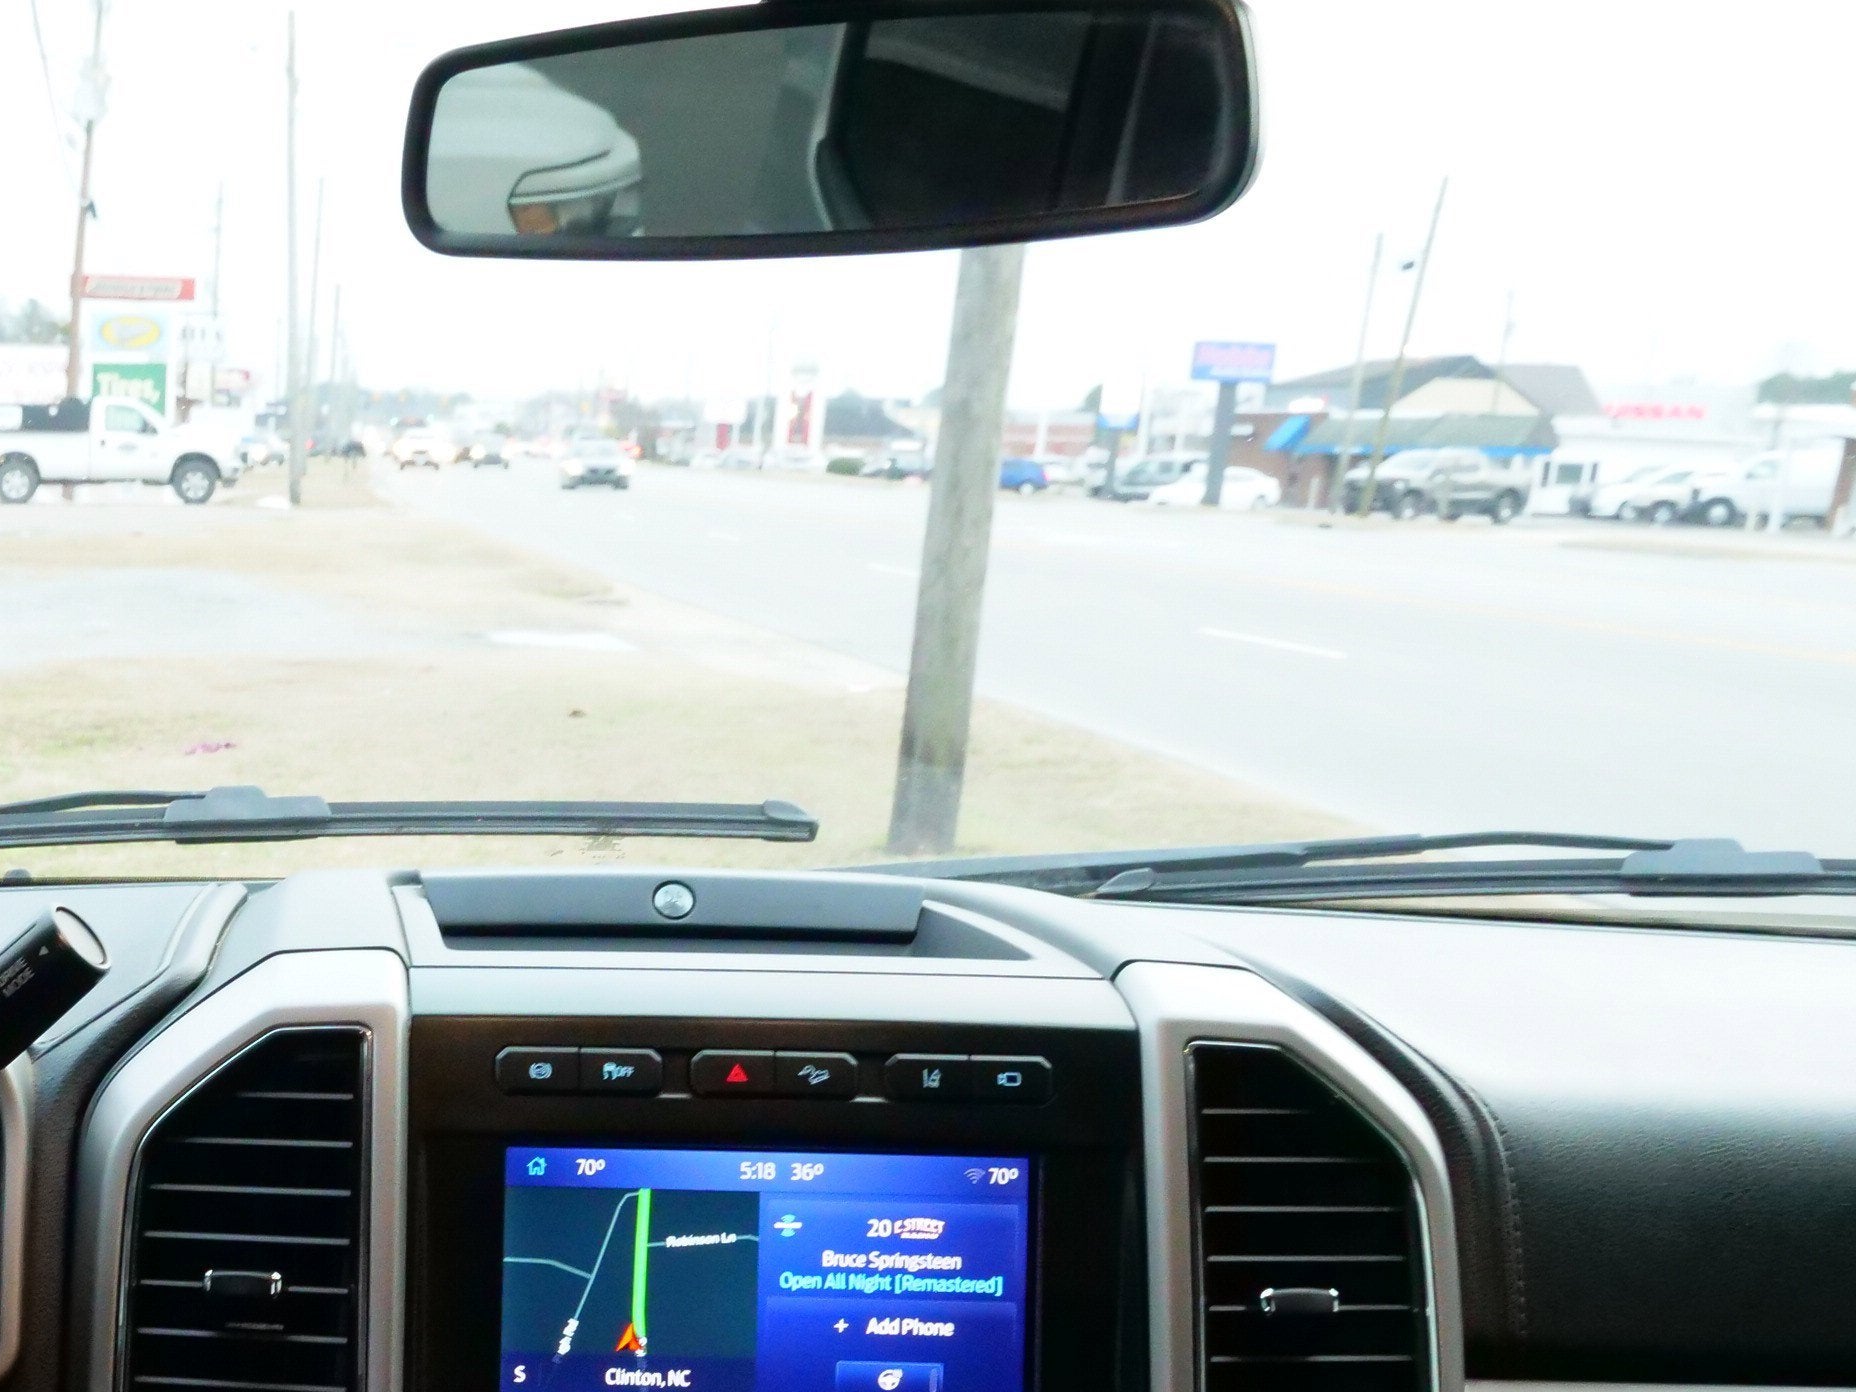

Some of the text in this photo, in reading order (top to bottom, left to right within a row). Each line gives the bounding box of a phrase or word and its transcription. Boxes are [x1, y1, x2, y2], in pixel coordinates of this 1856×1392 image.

[739, 1161, 777, 1181] 5:18
[866, 1218, 892, 1238] 20
[821, 1249, 962, 1272] Bruce Springsteen
[779, 1271, 1003, 1296] Open All Night [Remastered]
[866, 1317, 955, 1337] Add Phone
[513, 1365, 526, 1383] S
[605, 1367, 692, 1388] Clinton, NC
